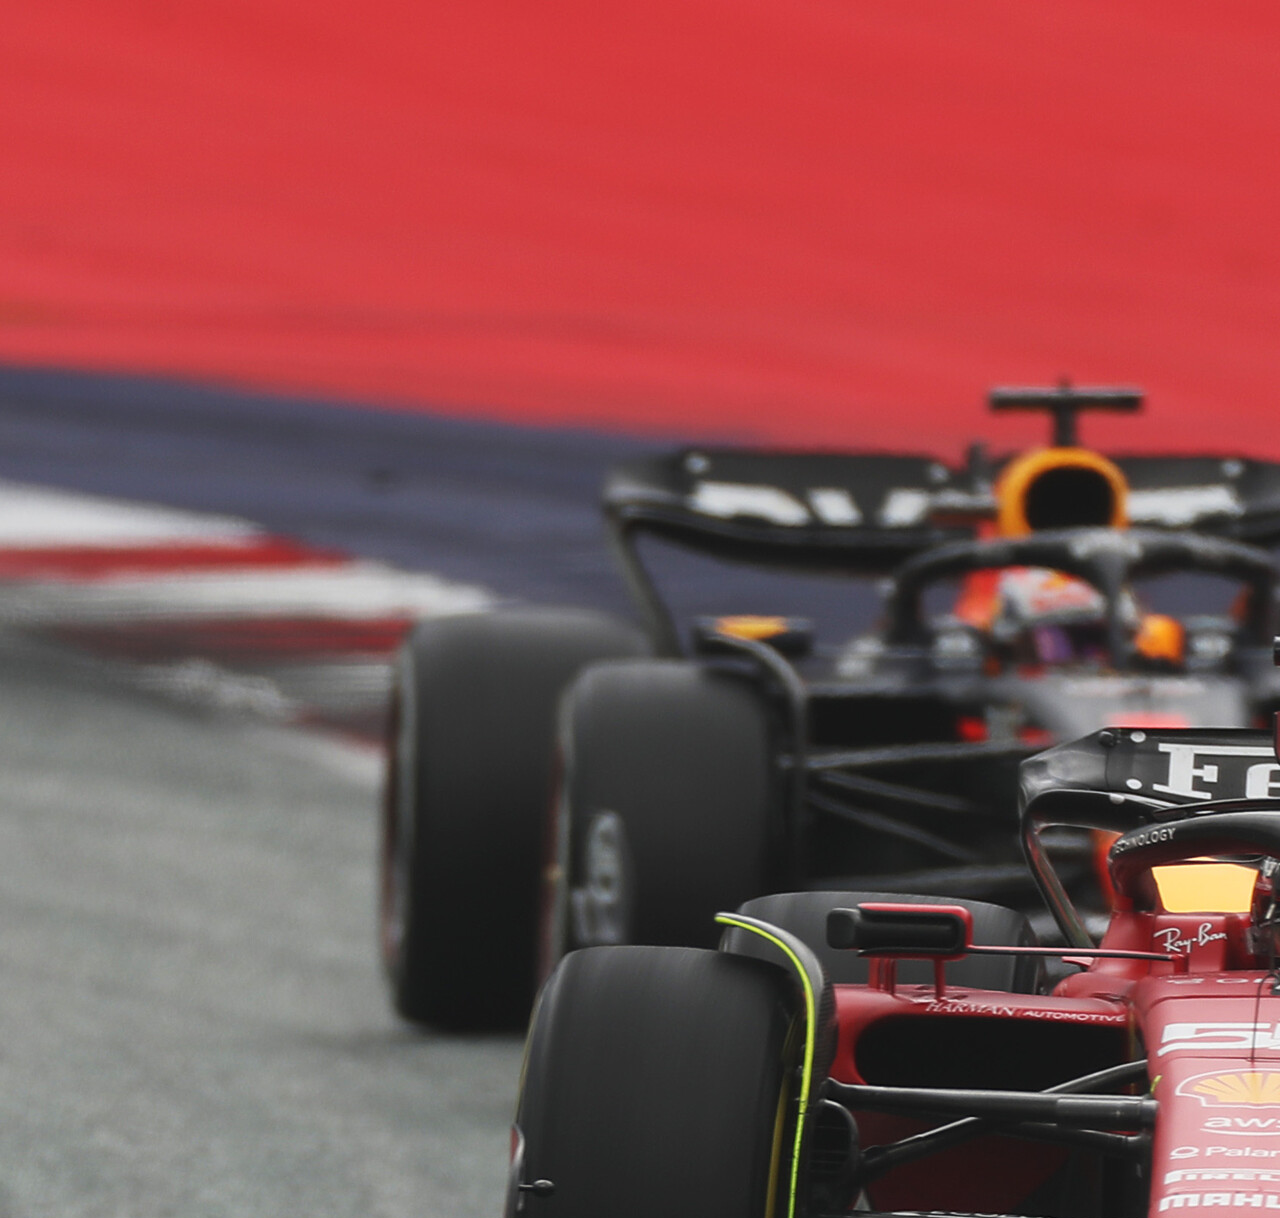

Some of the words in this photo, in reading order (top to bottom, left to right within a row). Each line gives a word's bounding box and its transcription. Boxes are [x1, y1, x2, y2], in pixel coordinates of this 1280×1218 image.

[1153, 922, 1228, 953] Ray-Ban
[925, 1000, 1017, 1016] HARMAN
[1022, 1010, 1126, 1022] AUTOMOTIVE
